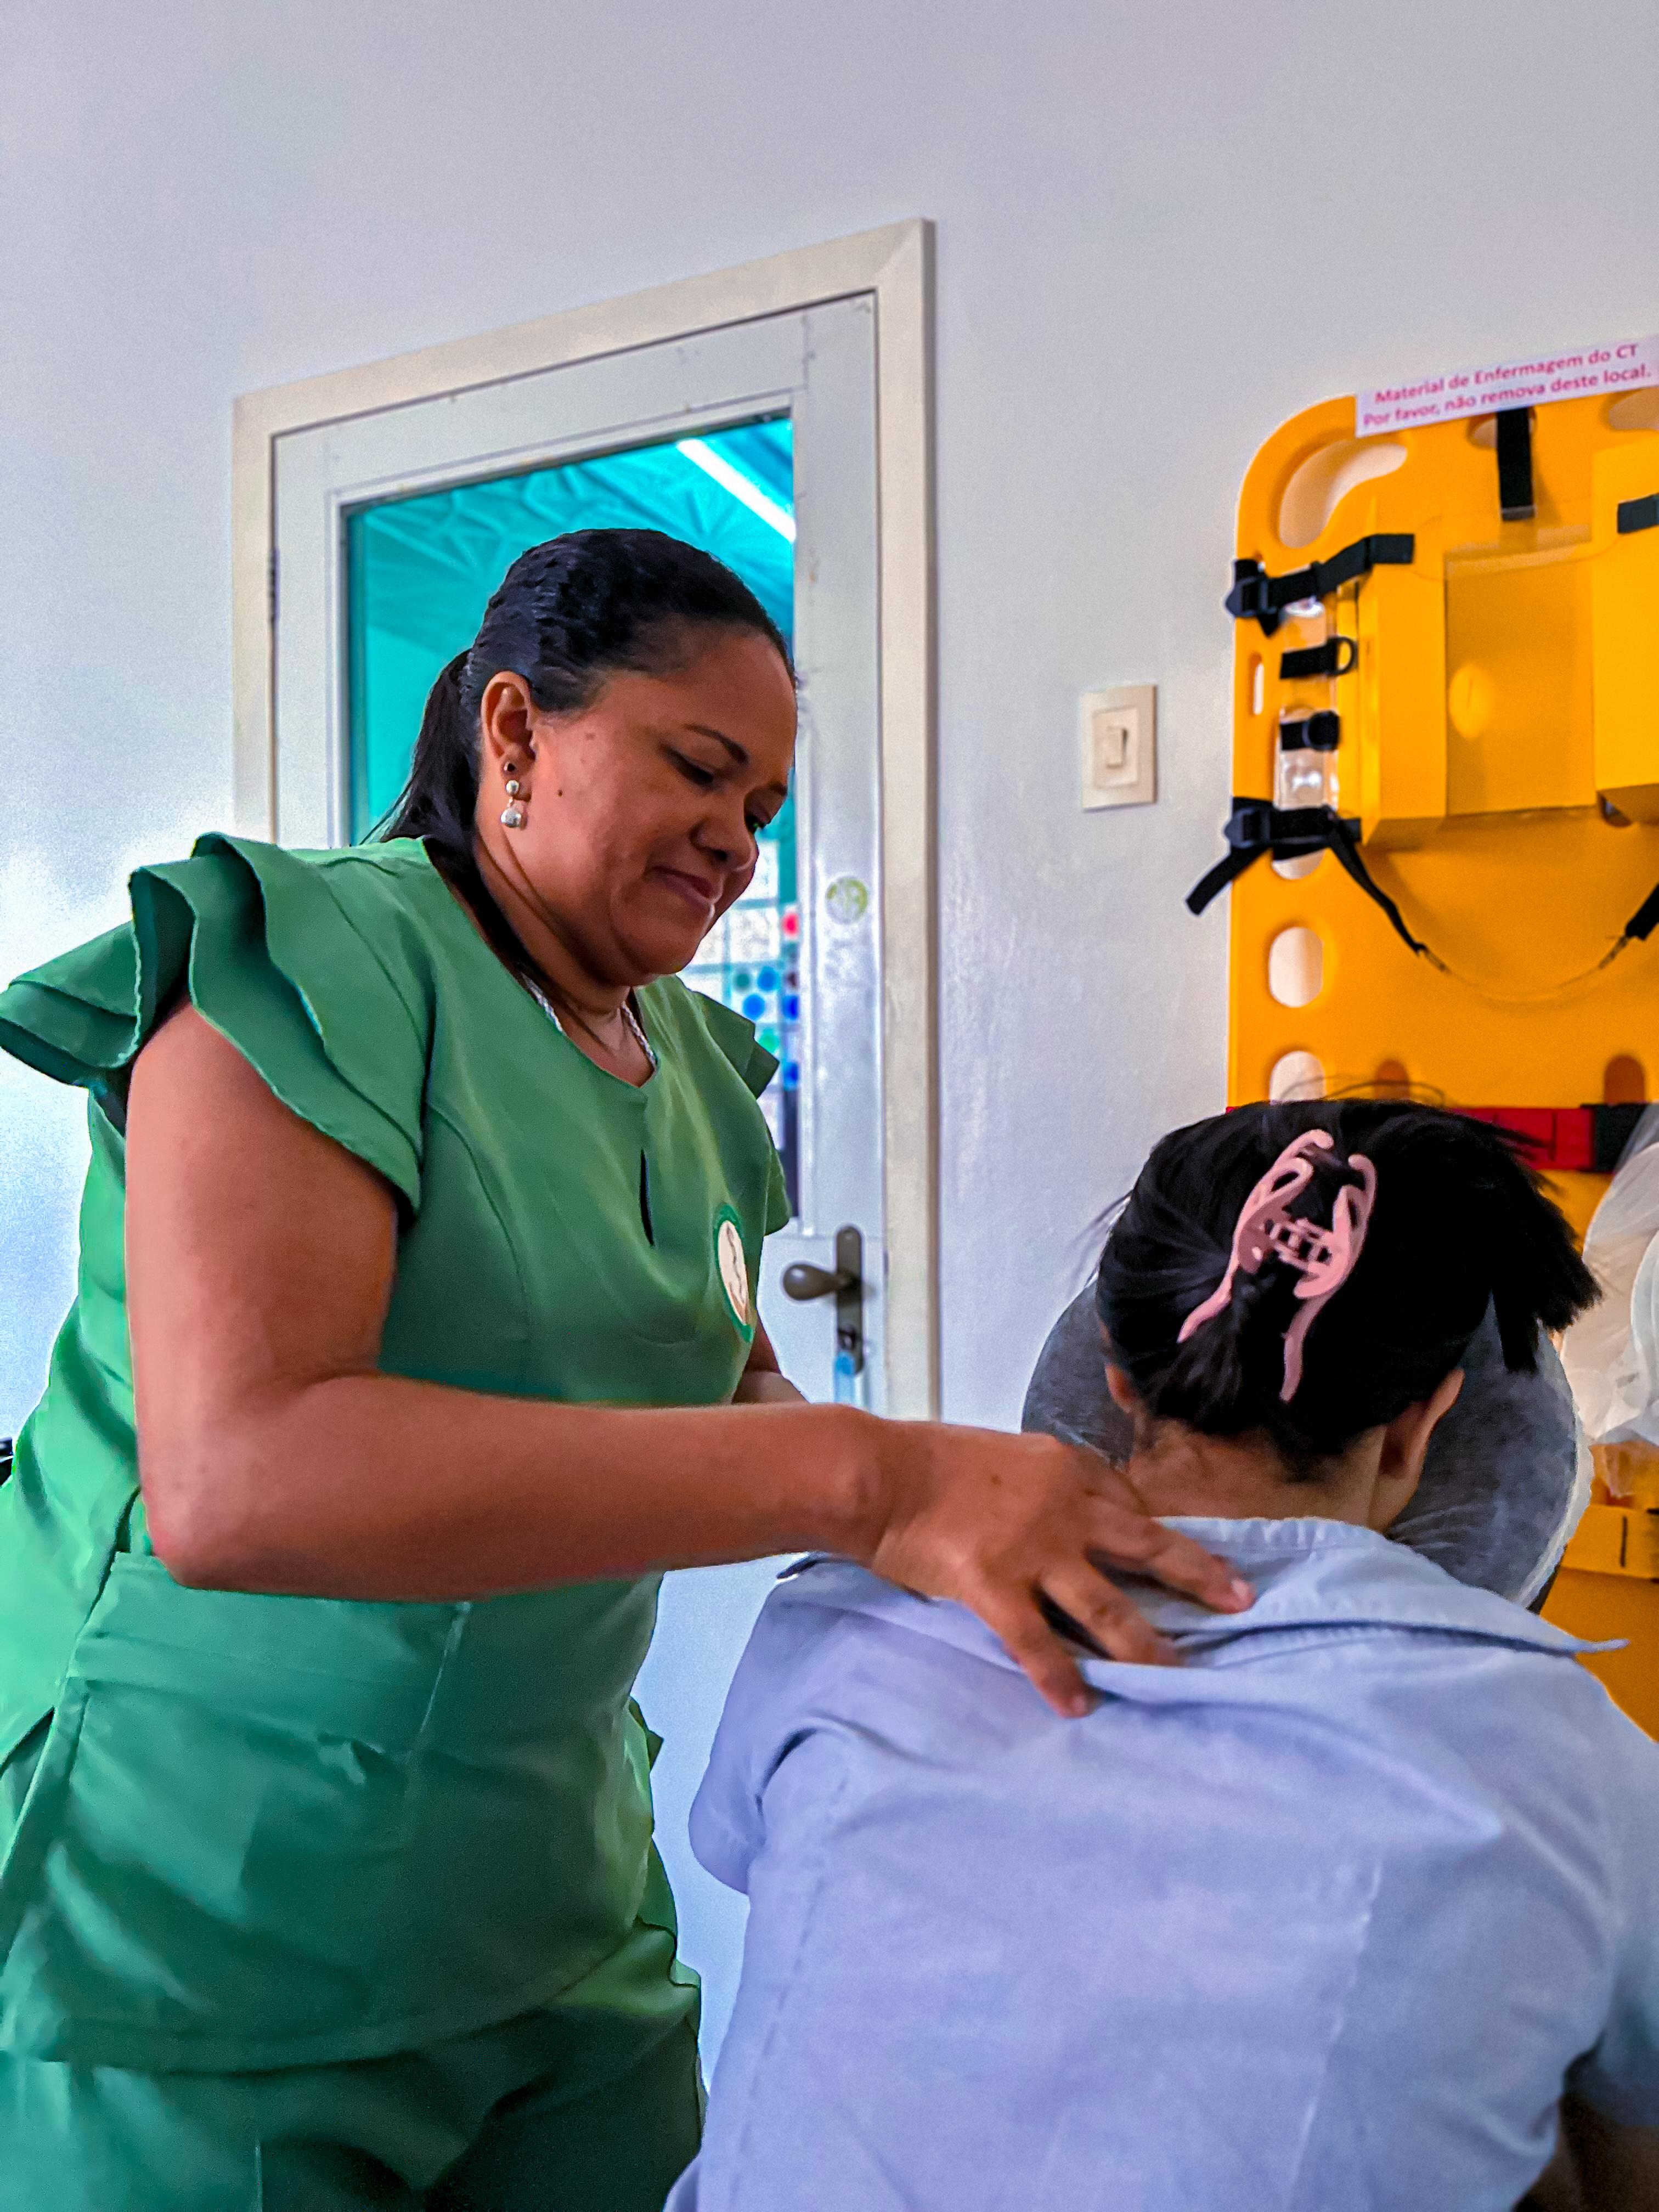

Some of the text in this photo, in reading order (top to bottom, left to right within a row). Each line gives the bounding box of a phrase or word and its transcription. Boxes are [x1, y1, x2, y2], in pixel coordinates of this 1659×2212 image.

[1364, 364, 1651, 426] Por favor, não remova deste local.
[1374, 344, 1638, 402] Material de Enfermagem do CT
